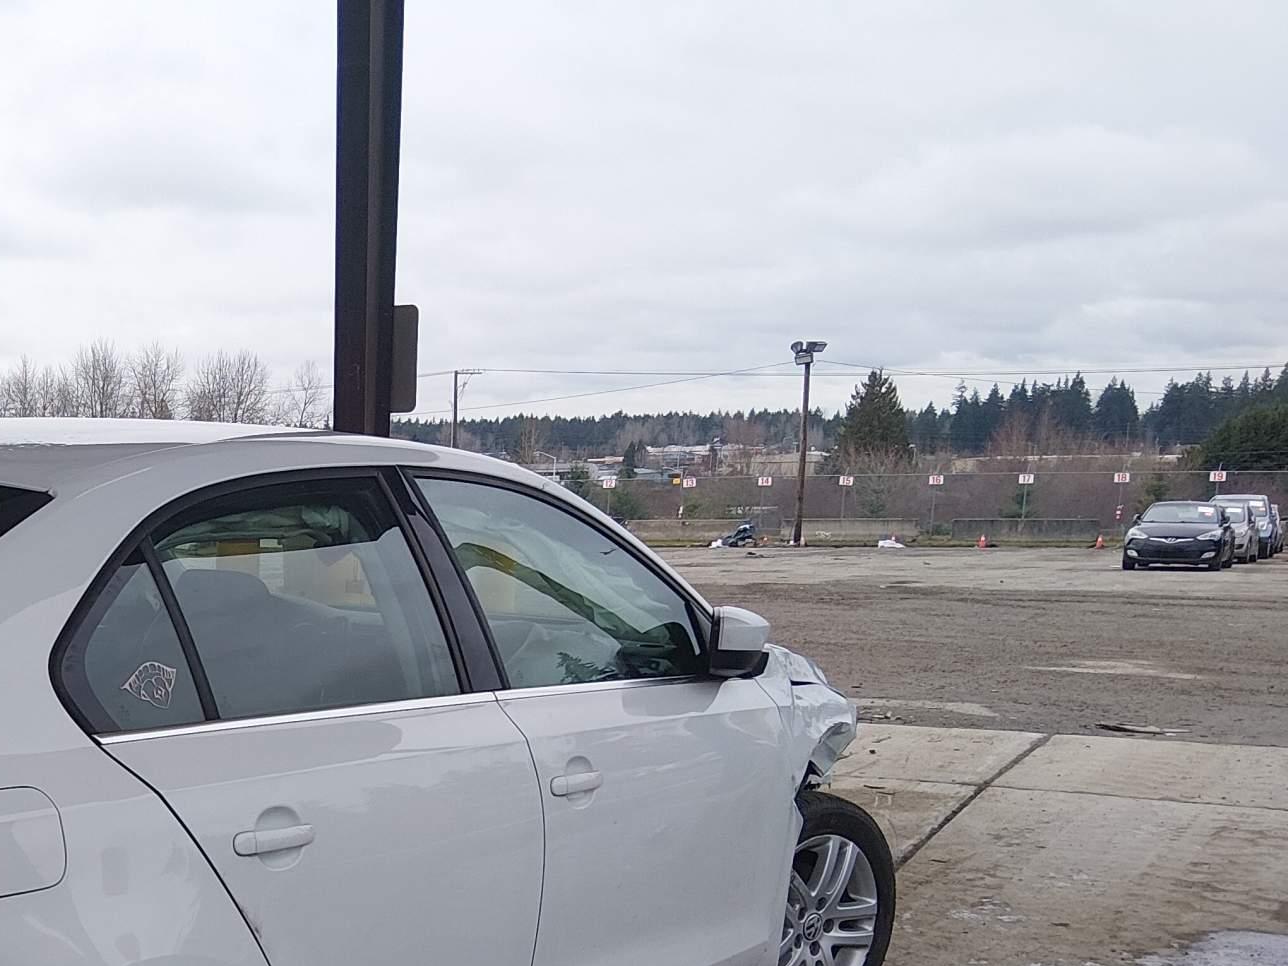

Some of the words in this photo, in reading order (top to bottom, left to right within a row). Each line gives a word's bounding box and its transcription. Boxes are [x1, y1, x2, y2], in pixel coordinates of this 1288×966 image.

[760, 477, 769, 485] 14
[841, 476, 851, 485] 15
[932, 475, 941, 484] 16
[1022, 474, 1030, 483] 17
[1117, 473, 1127, 482] 18
[1213, 472, 1224, 481] 19
[605, 479, 613, 487] 12
[685, 479, 694, 487] 13
